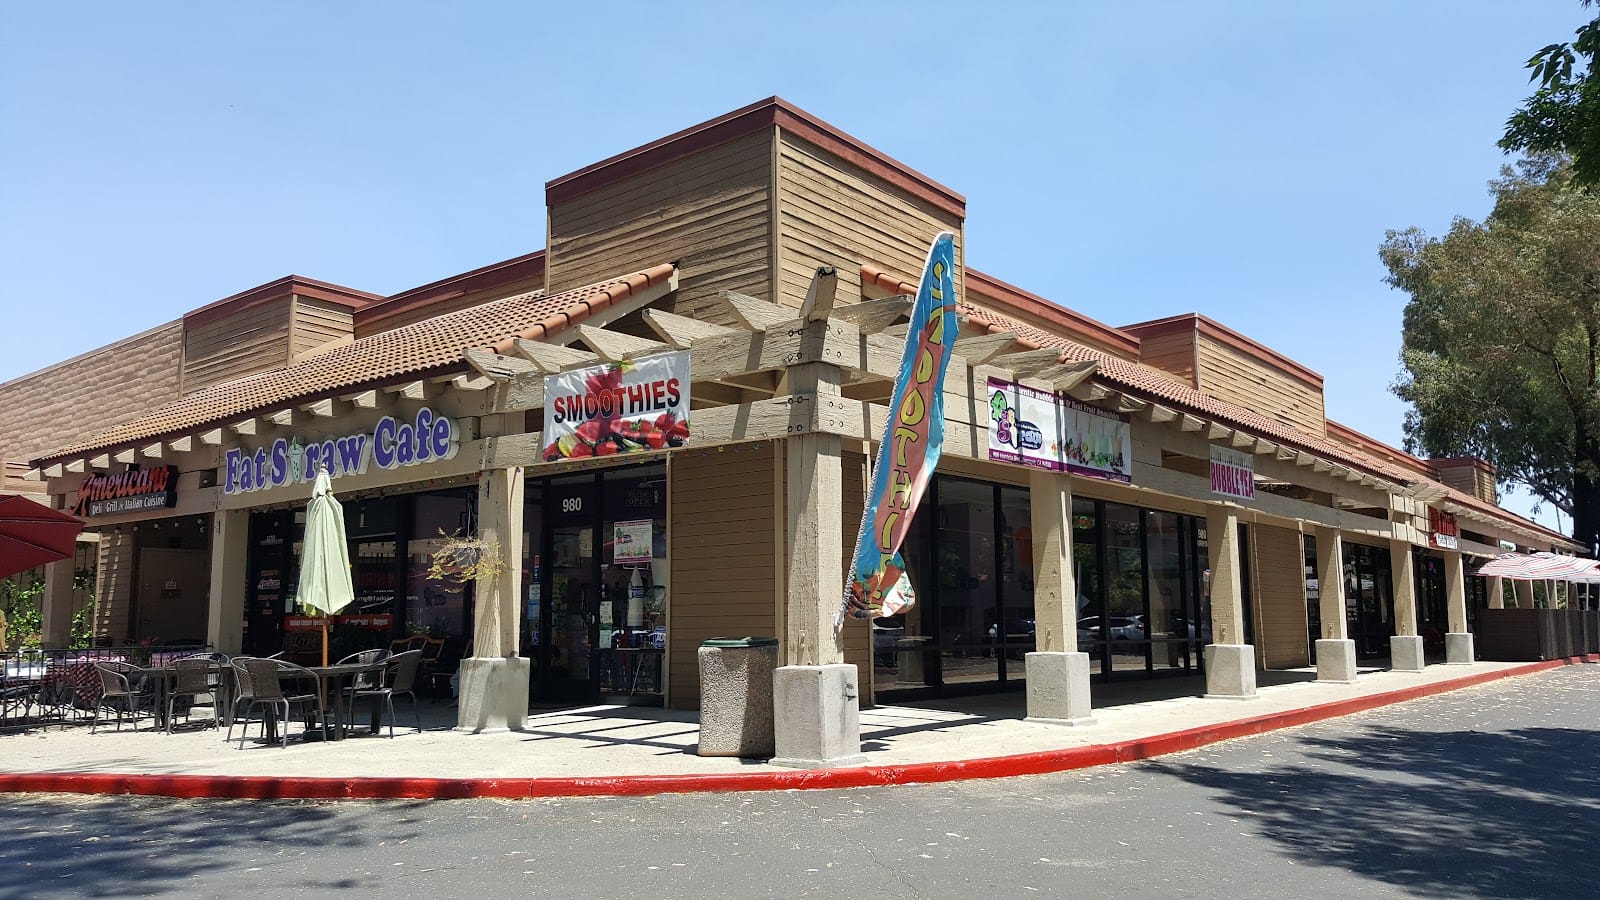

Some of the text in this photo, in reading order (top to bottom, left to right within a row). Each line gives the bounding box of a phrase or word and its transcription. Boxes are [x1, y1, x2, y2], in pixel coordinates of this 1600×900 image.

[553, 377, 681, 424] SMOOTHIES
[225, 447, 266, 495] Fat
[373, 406, 451, 469] Cafe
[1211, 462, 1255, 499] BUBBLE TEA
[106, 499, 118, 513] Grill
[144, 495, 165, 508] Cuisine
[562, 497, 582, 513] 980
